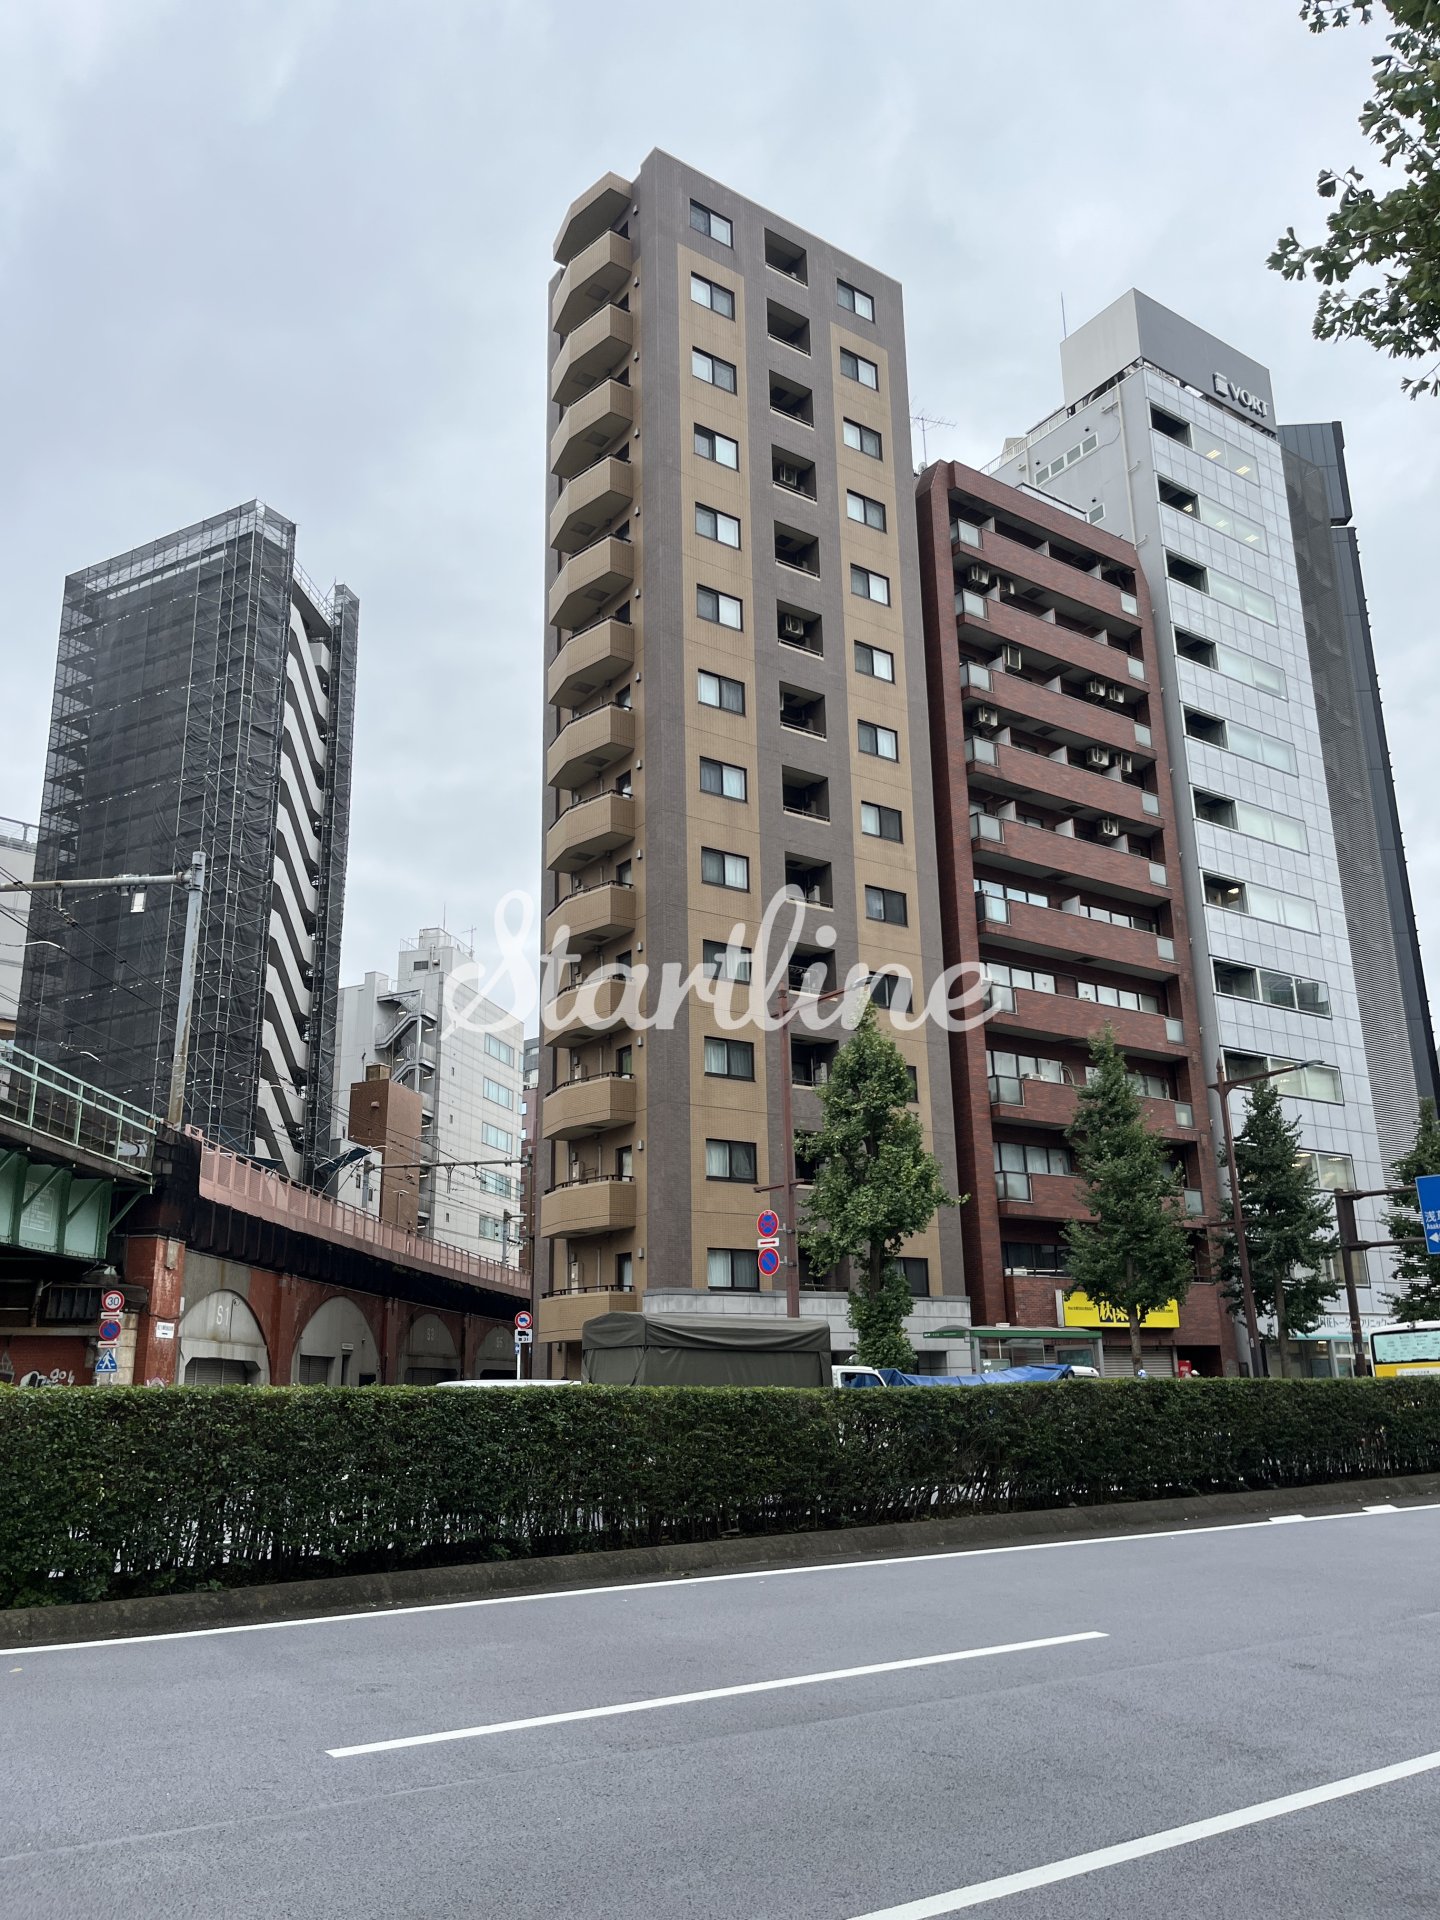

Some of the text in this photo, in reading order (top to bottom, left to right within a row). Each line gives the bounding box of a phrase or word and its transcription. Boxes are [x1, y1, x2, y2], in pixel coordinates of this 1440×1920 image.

[1229, 382, 1269, 417] VORT
[107, 1296, 120, 1306] 30
[216, 1305, 229, 1326] S1
